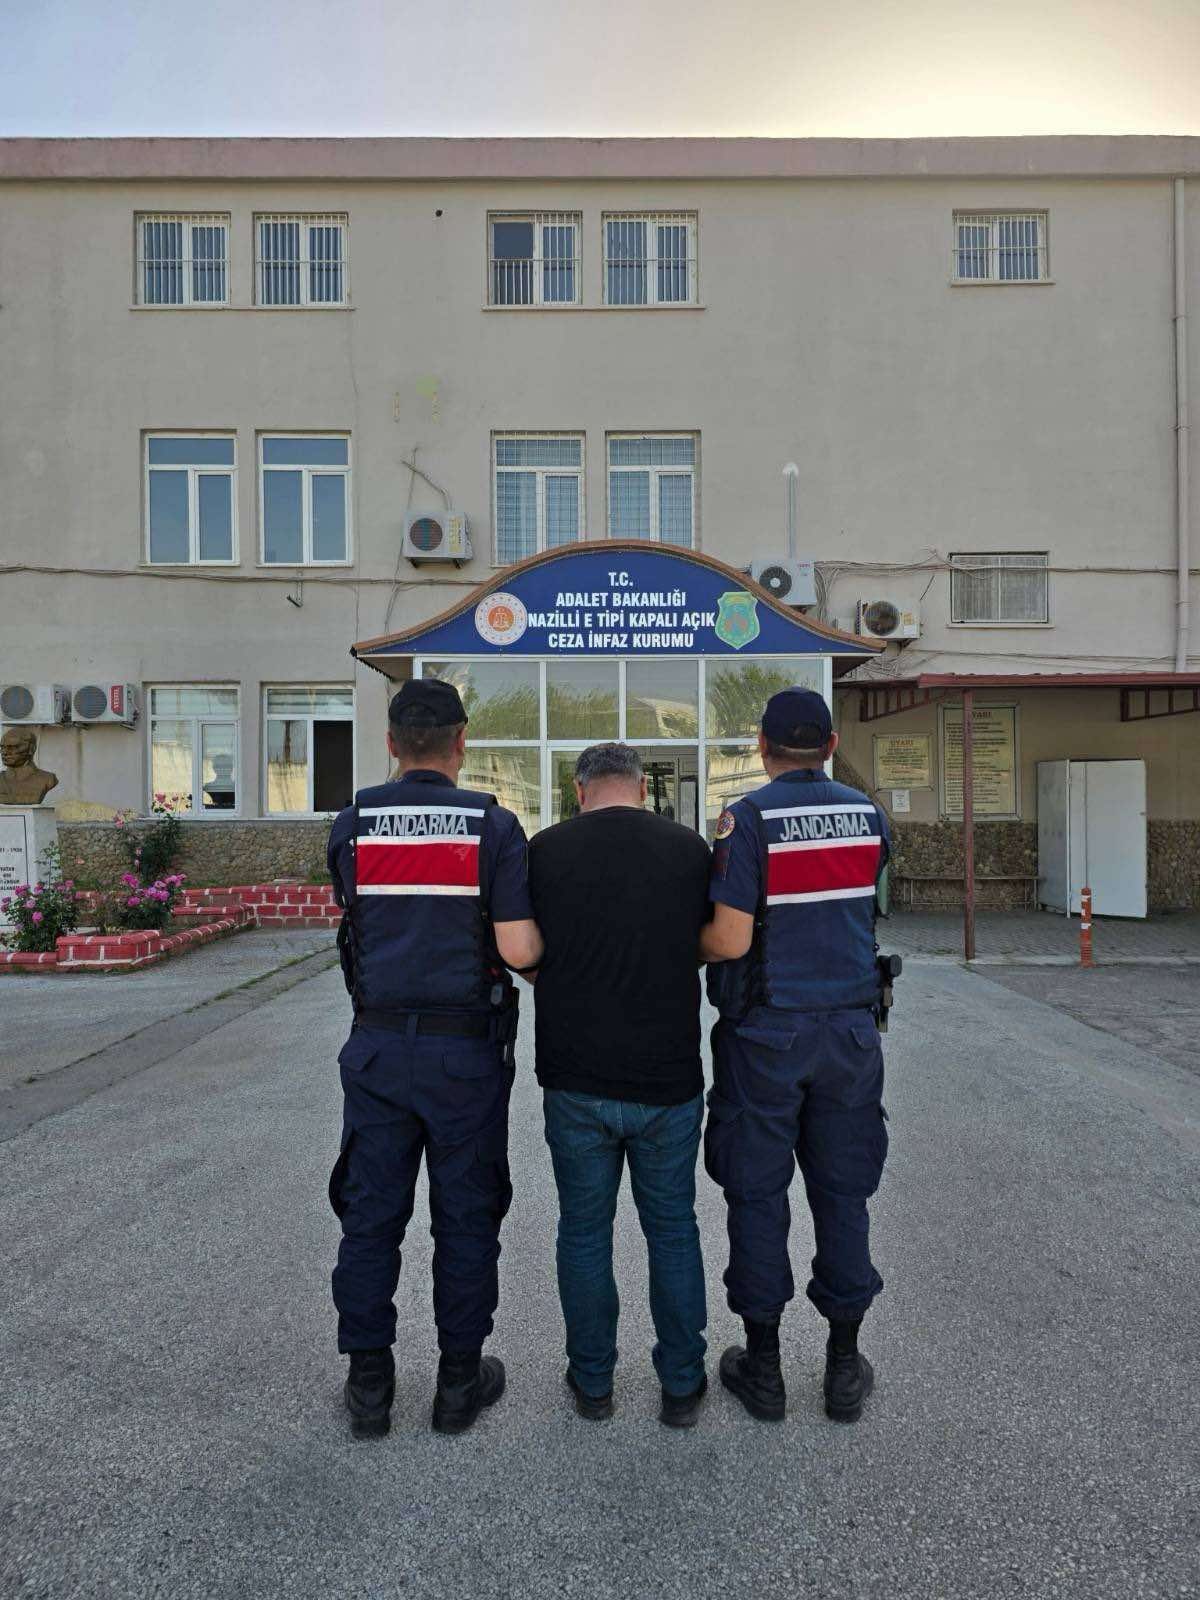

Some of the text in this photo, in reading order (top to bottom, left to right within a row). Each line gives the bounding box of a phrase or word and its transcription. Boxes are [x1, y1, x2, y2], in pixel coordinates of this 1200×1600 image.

[608, 572, 634, 587] T.C.
[555, 588, 686, 607] ADALET BAKANLIĞI
[528, 611, 715, 630] NAZİLLİ E TİPİ KAPALI AÇIK
[548, 631, 694, 648] CEZA İNFAZ KURUMU
[368, 814, 468, 836] JANDARMA
[780, 813, 872, 841] JANDARMA
